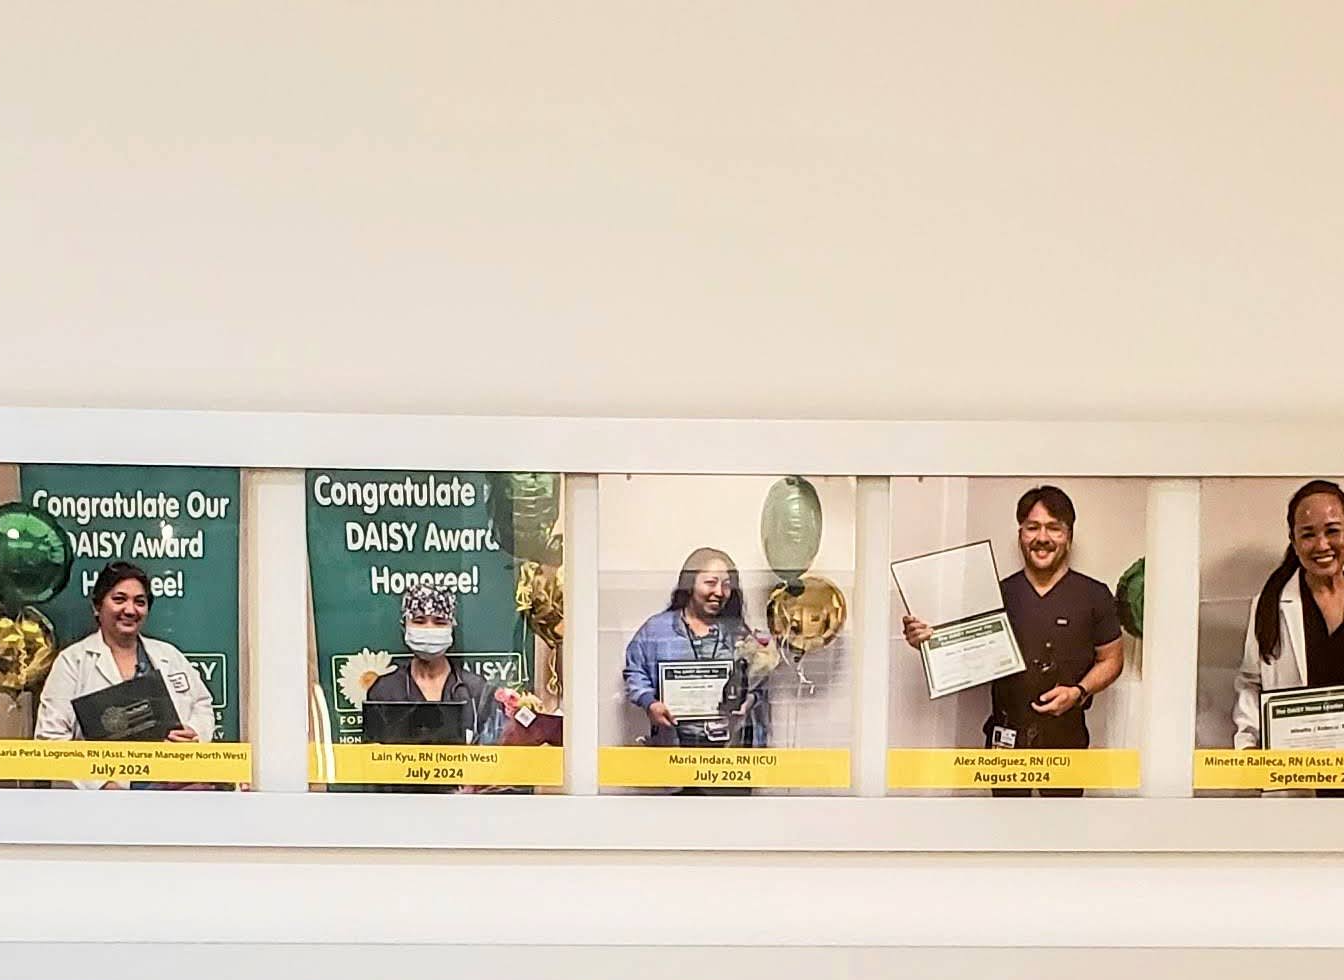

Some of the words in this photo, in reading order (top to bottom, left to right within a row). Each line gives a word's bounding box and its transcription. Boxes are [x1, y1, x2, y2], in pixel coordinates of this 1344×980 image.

[314, 473, 475, 514] Congratulate
[186, 490, 229, 518] Our
[345, 521, 417, 551] DAISY
[131, 531, 203, 558] Award
[82, 568, 183, 598] Hee!
[668, 754, 696, 764] Maria
[699, 754, 733, 765] Indara,
[736, 754, 750, 765] RN
[752, 755, 776, 766] (ICU)
[1204, 756, 1244, 766] Minette
[1246, 756, 1286, 767] Ralleca,
[1288, 756, 1303, 766] RN
[1305, 756, 1333, 767] (Asst.
[90, 763, 116, 777] July
[118, 764, 150, 775] 2024
[405, 766, 430, 781] July
[433, 767, 463, 778] 2024
[693, 769, 718, 783] July
[721, 770, 751, 781] 2024
[973, 771, 1017, 785] August
[1019, 771, 1050, 782] 2024
[1269, 771, 1338, 785] September
